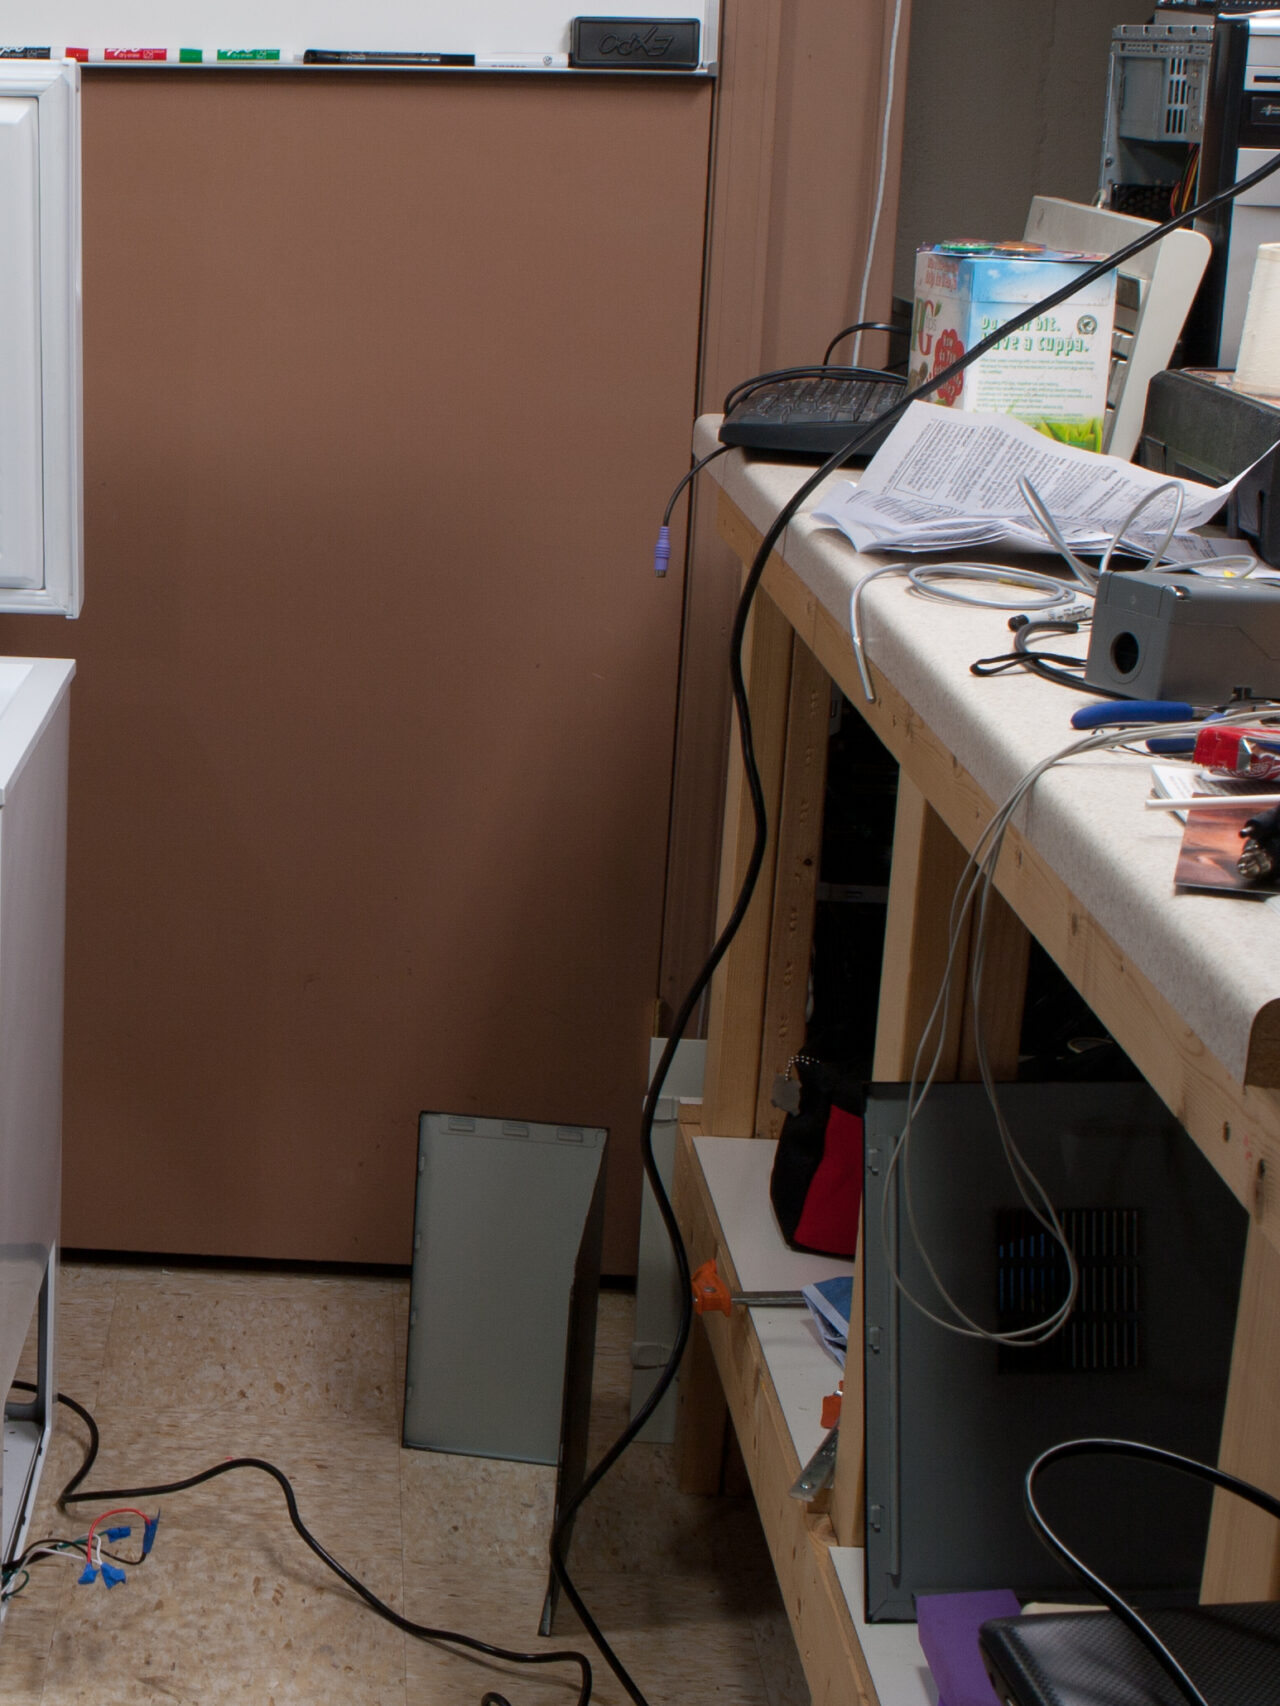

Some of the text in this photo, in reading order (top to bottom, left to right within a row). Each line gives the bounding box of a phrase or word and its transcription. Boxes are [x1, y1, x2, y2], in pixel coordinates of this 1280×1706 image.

[981, 316, 999, 330] Do
[1035, 316, 1062, 332] bit.
[981, 332, 1090, 357] ave a cuppa.
